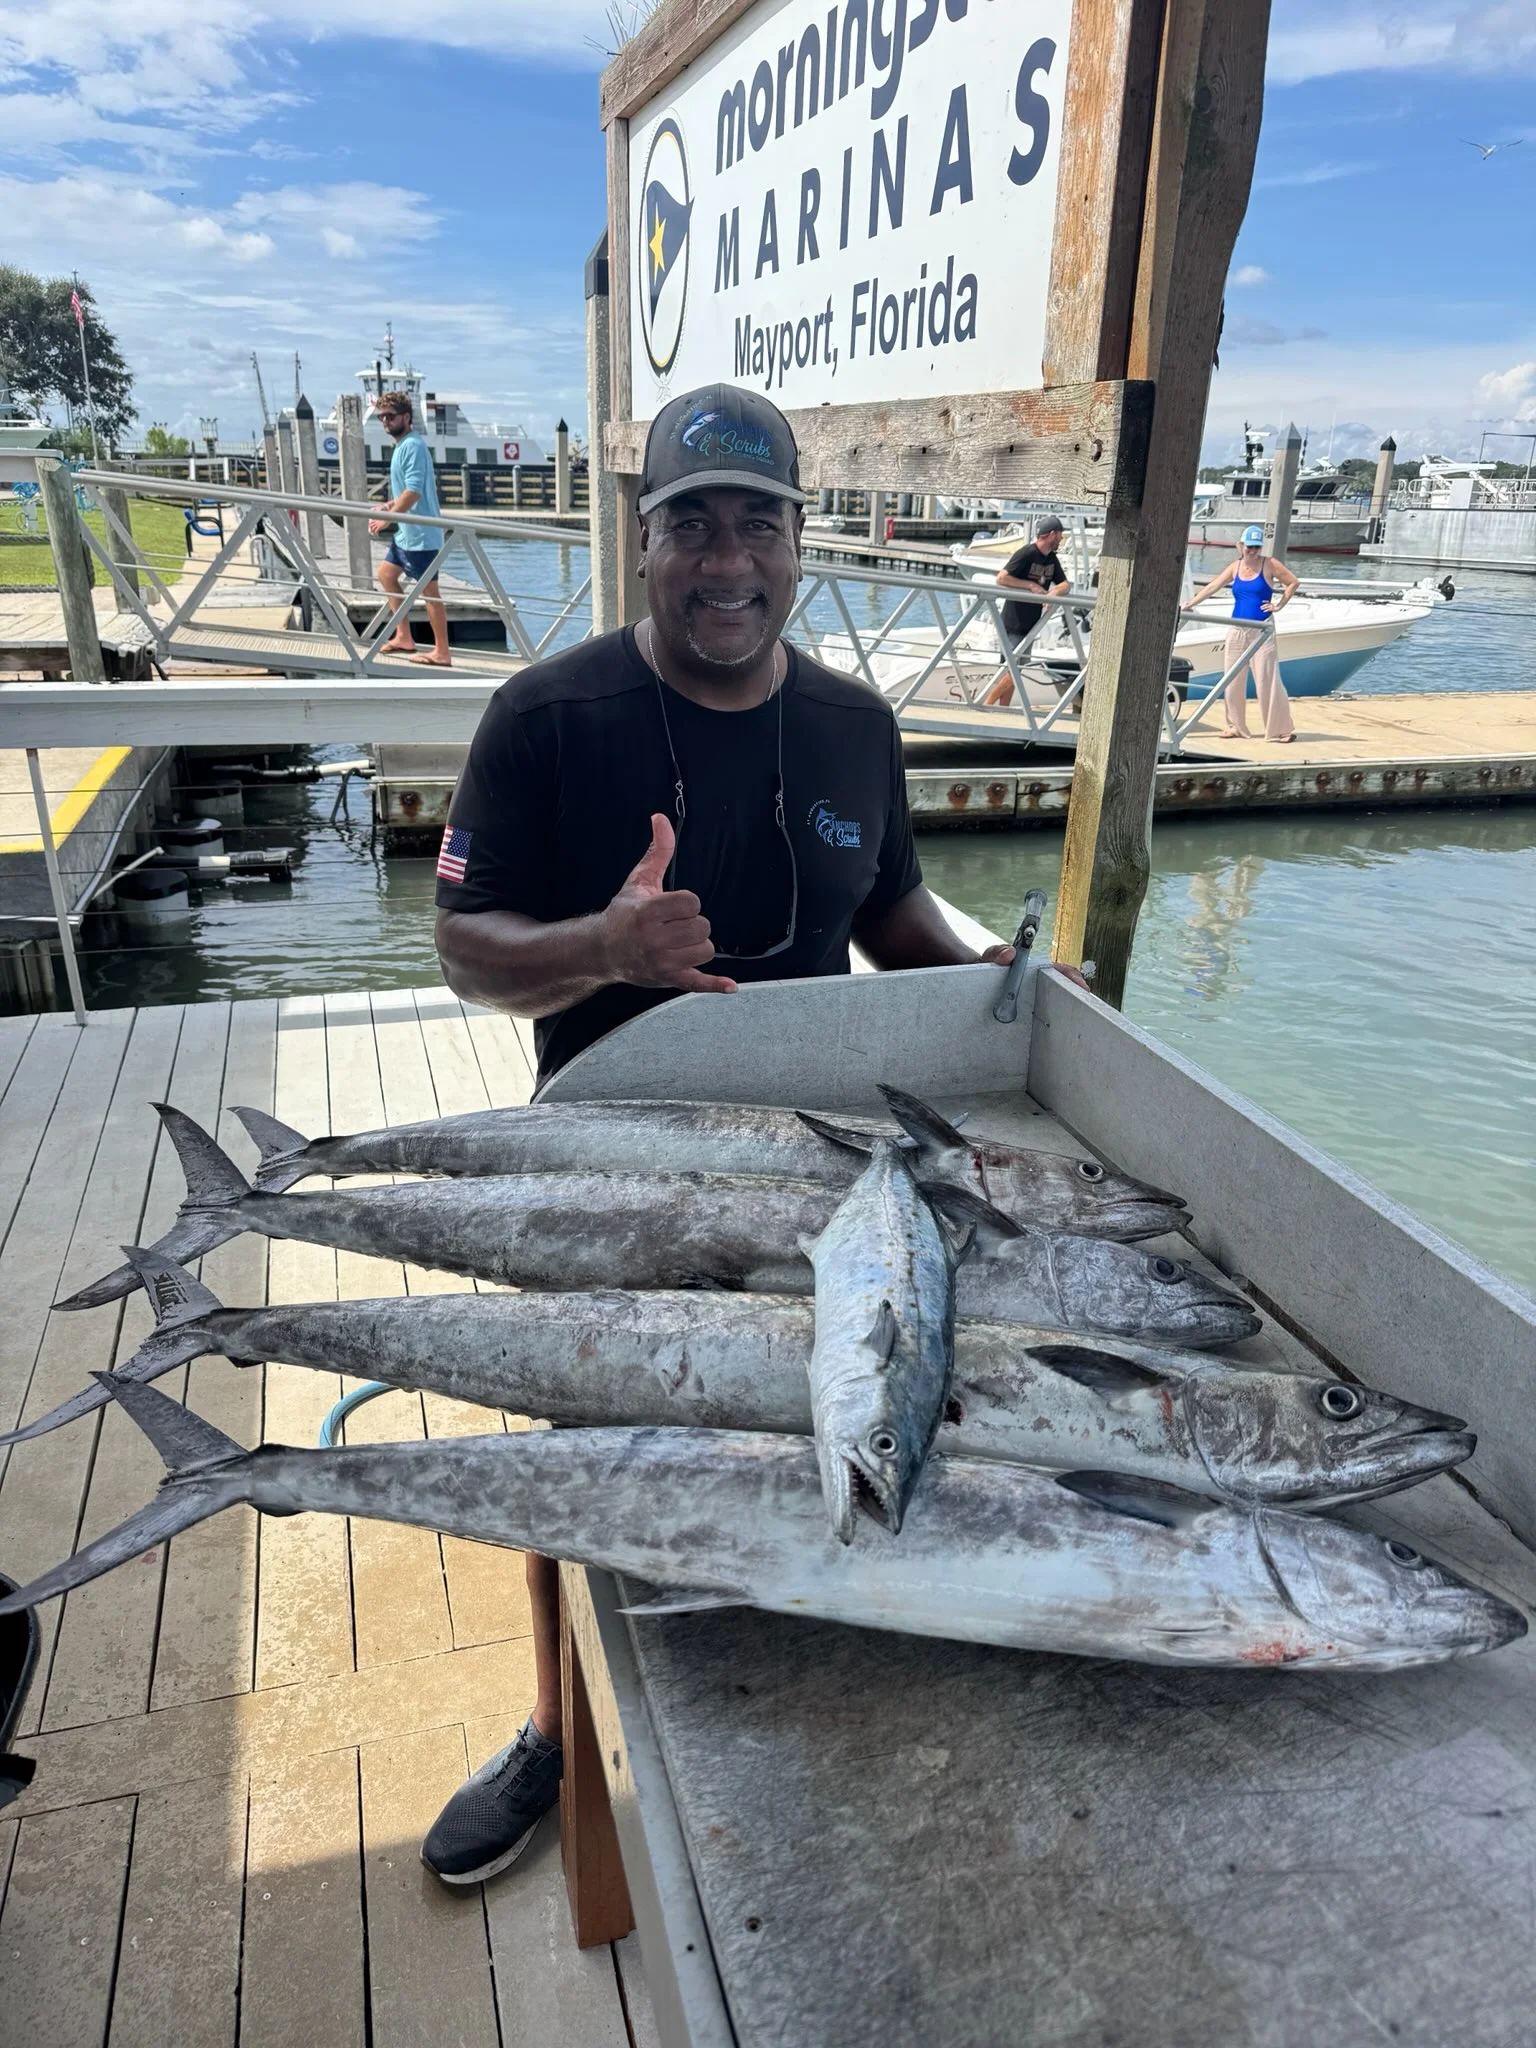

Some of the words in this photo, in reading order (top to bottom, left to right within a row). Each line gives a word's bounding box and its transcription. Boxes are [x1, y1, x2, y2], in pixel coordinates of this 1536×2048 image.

[714, 37, 1057, 293] MARINAS
[716, 0, 969, 175] morning
[734, 294, 838, 391] Mayport,
[850, 255, 978, 359] Florida
[717, 430, 771, 457] Scrubs
